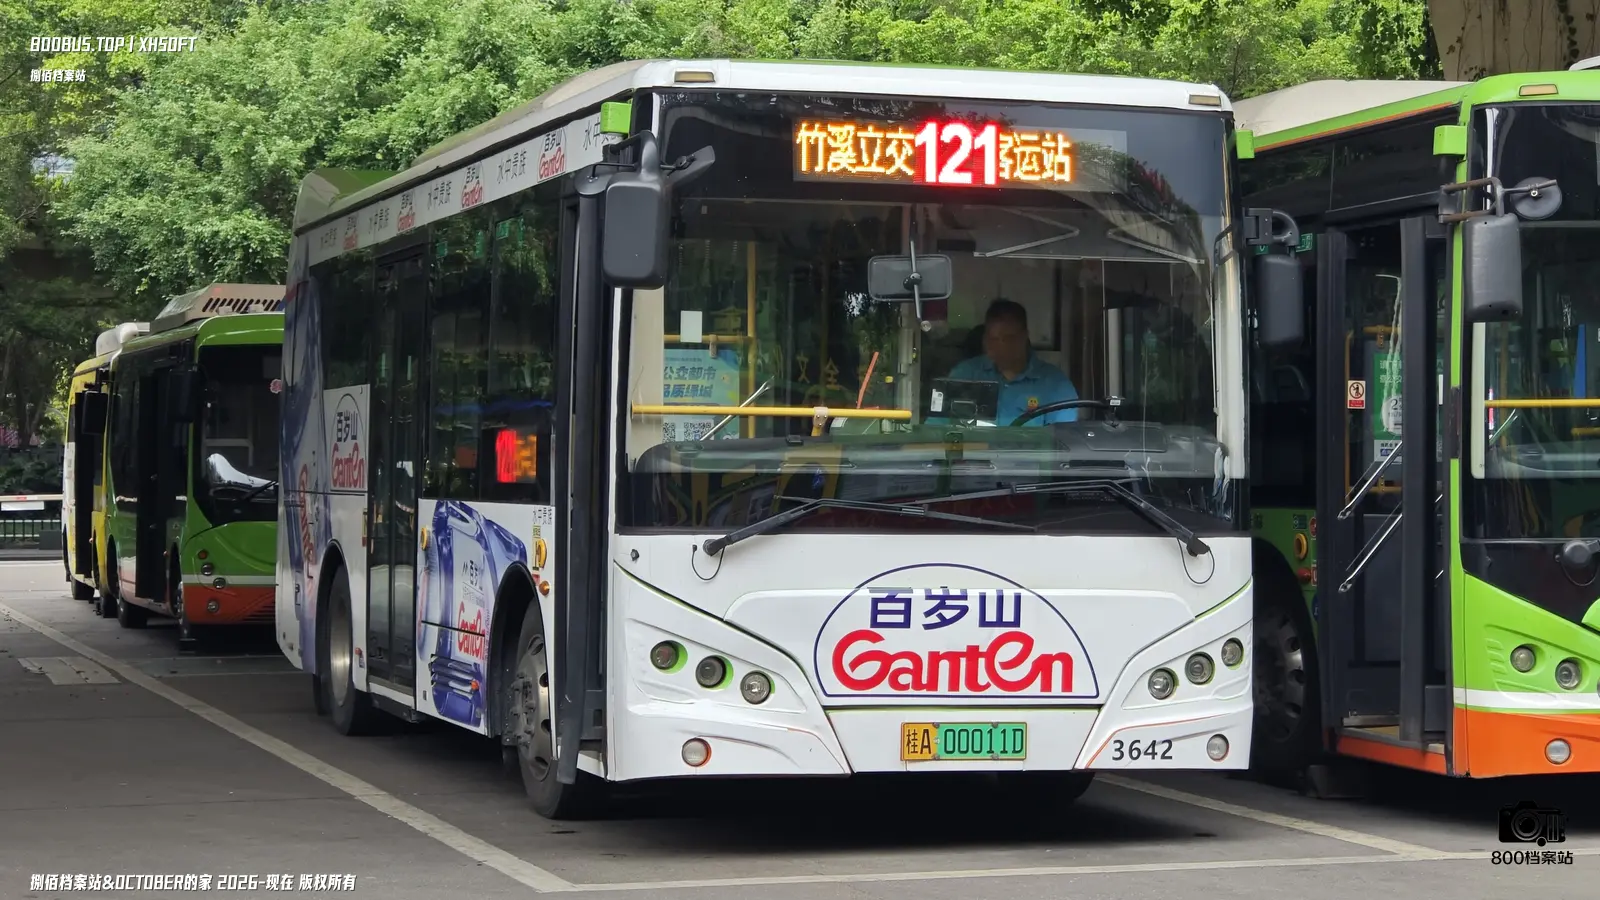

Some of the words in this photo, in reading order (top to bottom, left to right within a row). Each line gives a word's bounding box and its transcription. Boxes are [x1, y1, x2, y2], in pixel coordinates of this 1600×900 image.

[796, 122, 915, 176] 竹溪立交
[914, 121, 998, 185] 121
[336, 411, 357, 442] 百岁山
[867, 586, 1022, 630] 百岁山
[832, 629, 1073, 693] Ganten
[905, 727, 932, 757] 桂A
[943, 728, 1025, 756] 00011D
[1112, 739, 1174, 761] 3642
